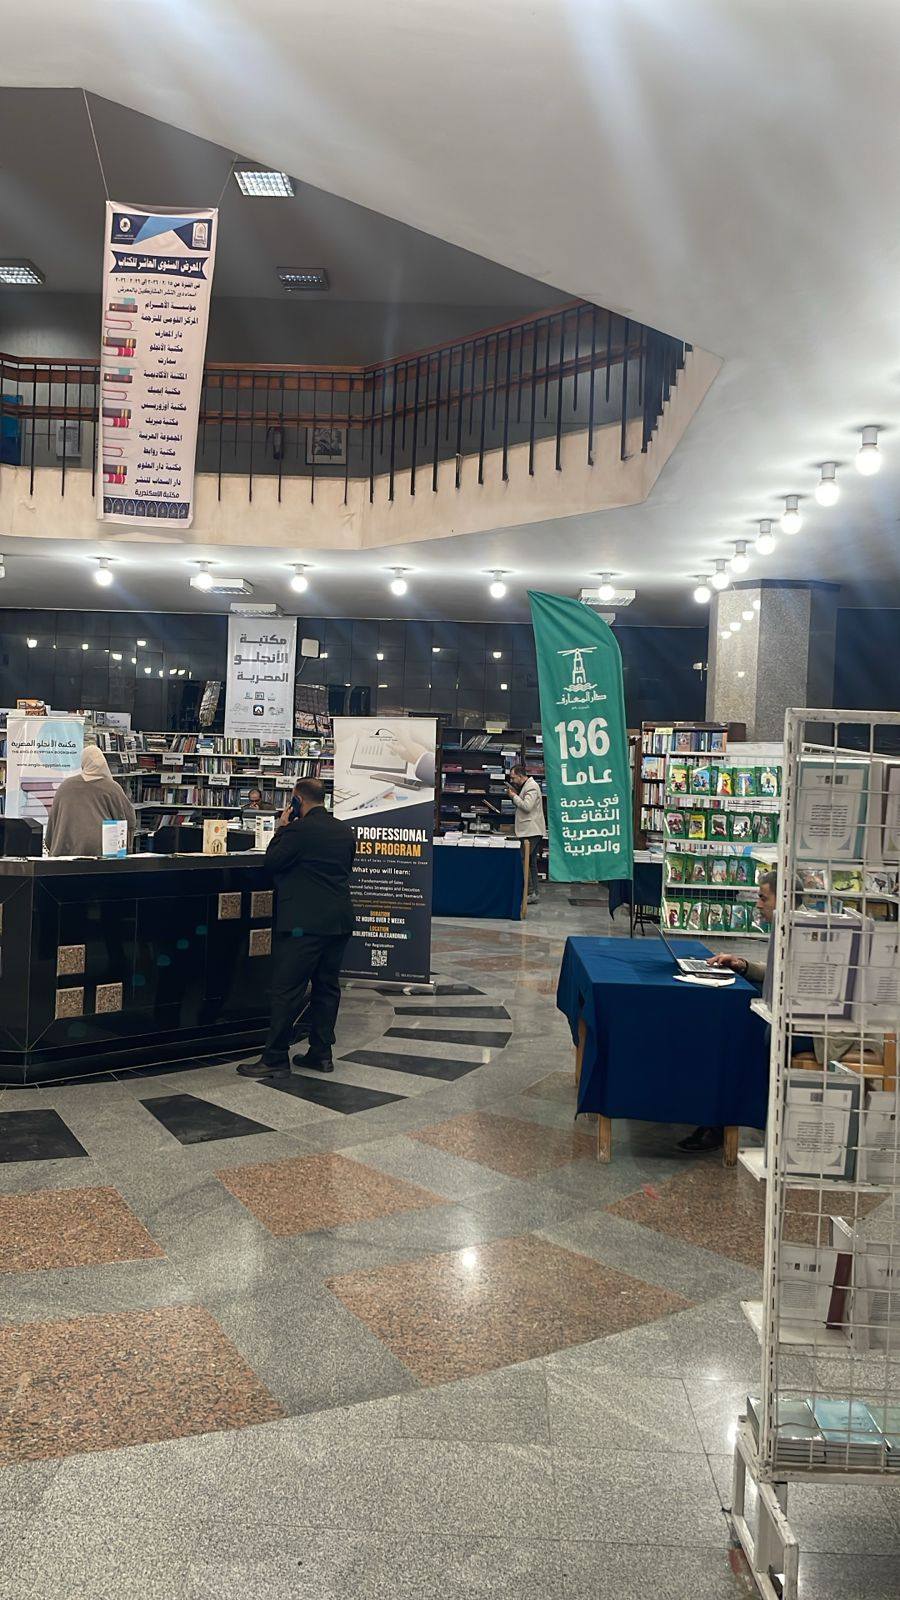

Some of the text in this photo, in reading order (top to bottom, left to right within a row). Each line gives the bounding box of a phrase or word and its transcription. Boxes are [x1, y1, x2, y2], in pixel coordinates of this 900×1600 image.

[118, 257, 137, 268] للكتاب
[138, 258, 157, 270] العاشر
[180, 260, 201, 273] المعرض
[184, 317, 198, 325] المركز
[155, 330, 173, 338] المعارف
[167, 344, 183, 352] مكتبة
[164, 386, 180, 395] مكتبة
[170, 403, 186, 411] مكتبة
[160, 448, 176, 456] مكتبة
[165, 463, 182, 472] مكتبة
[172, 479, 181, 487] دار
[163, 491, 180, 499] مكتبة
[240, 633, 287, 646] مكتبة
[234, 650, 288, 665] الأنجلو
[237, 671, 288, 684] المصرية
[554, 717, 611, 760] 136
[561, 796, 595, 808] خدمة
[561, 808, 620, 823] الثقافة
[357, 826, 428, 842] PROFESSIONAL
[562, 824, 620, 840] المصرية
[356, 841, 421, 857] LES PROGRAM
[564, 840, 620, 856] والعربية
